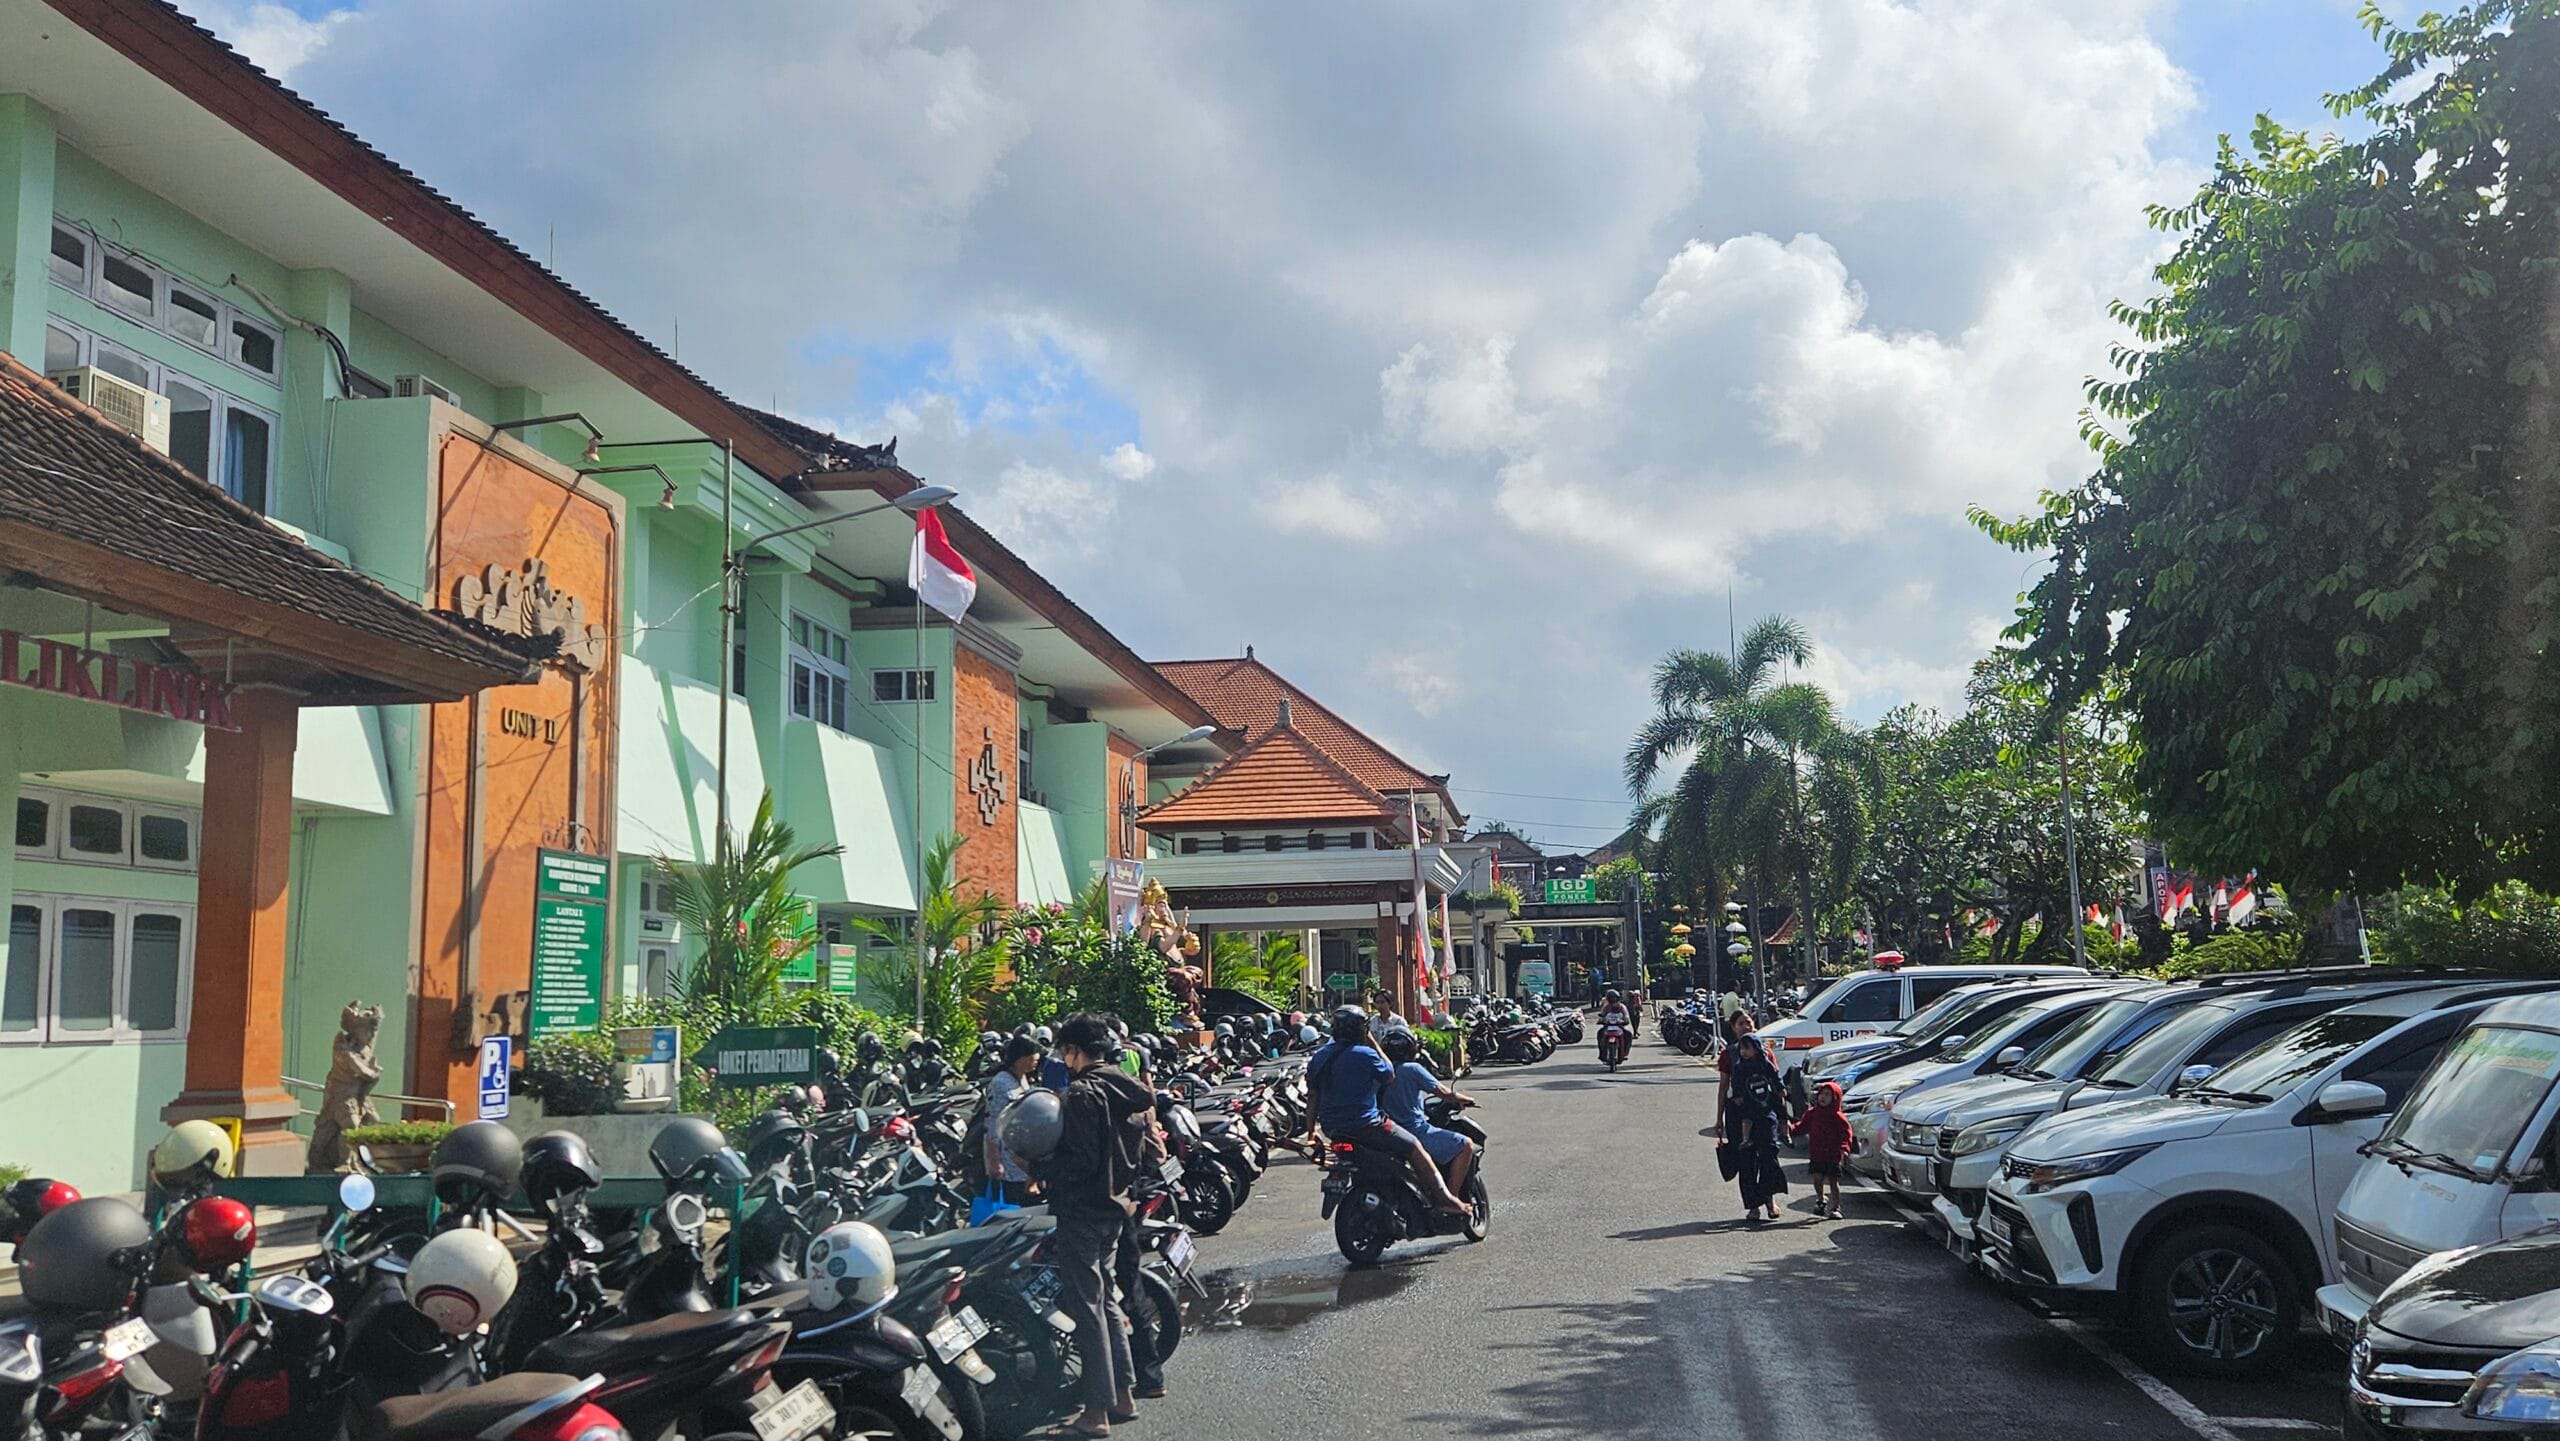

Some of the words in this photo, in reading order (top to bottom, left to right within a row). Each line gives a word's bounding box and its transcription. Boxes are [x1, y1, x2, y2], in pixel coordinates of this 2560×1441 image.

[501, 706, 542, 741] UNIT
[1552, 879, 1587, 891] IGD
[1830, 1029, 1853, 1041] BRI
[482, 1041, 501, 1078] P
[718, 1050, 745, 1075] LOKET
[747, 1048, 810, 1074] PENDAFTARAN
